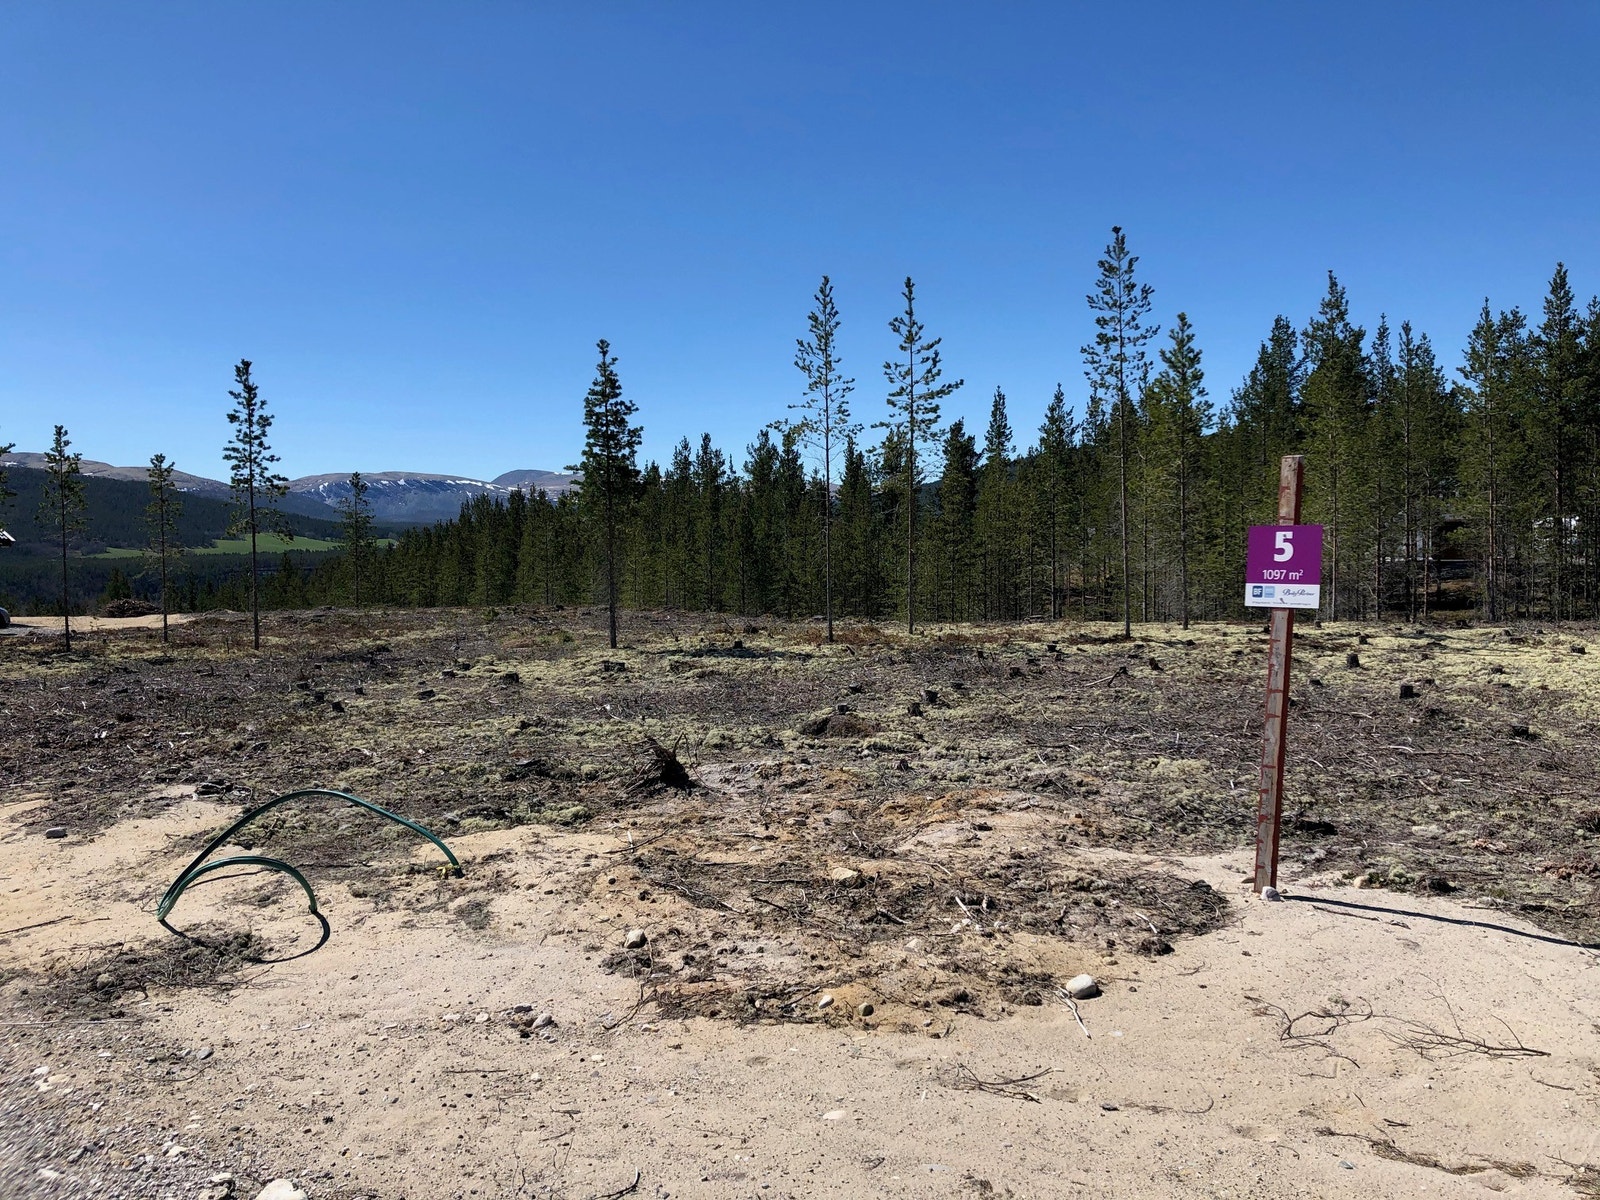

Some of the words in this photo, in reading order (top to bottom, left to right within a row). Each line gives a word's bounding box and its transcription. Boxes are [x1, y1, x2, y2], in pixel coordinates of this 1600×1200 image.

[1273, 531, 1294, 562] 5
[1262, 569, 1287, 580] 1097
[1288, 569, 1304, 580] m²
